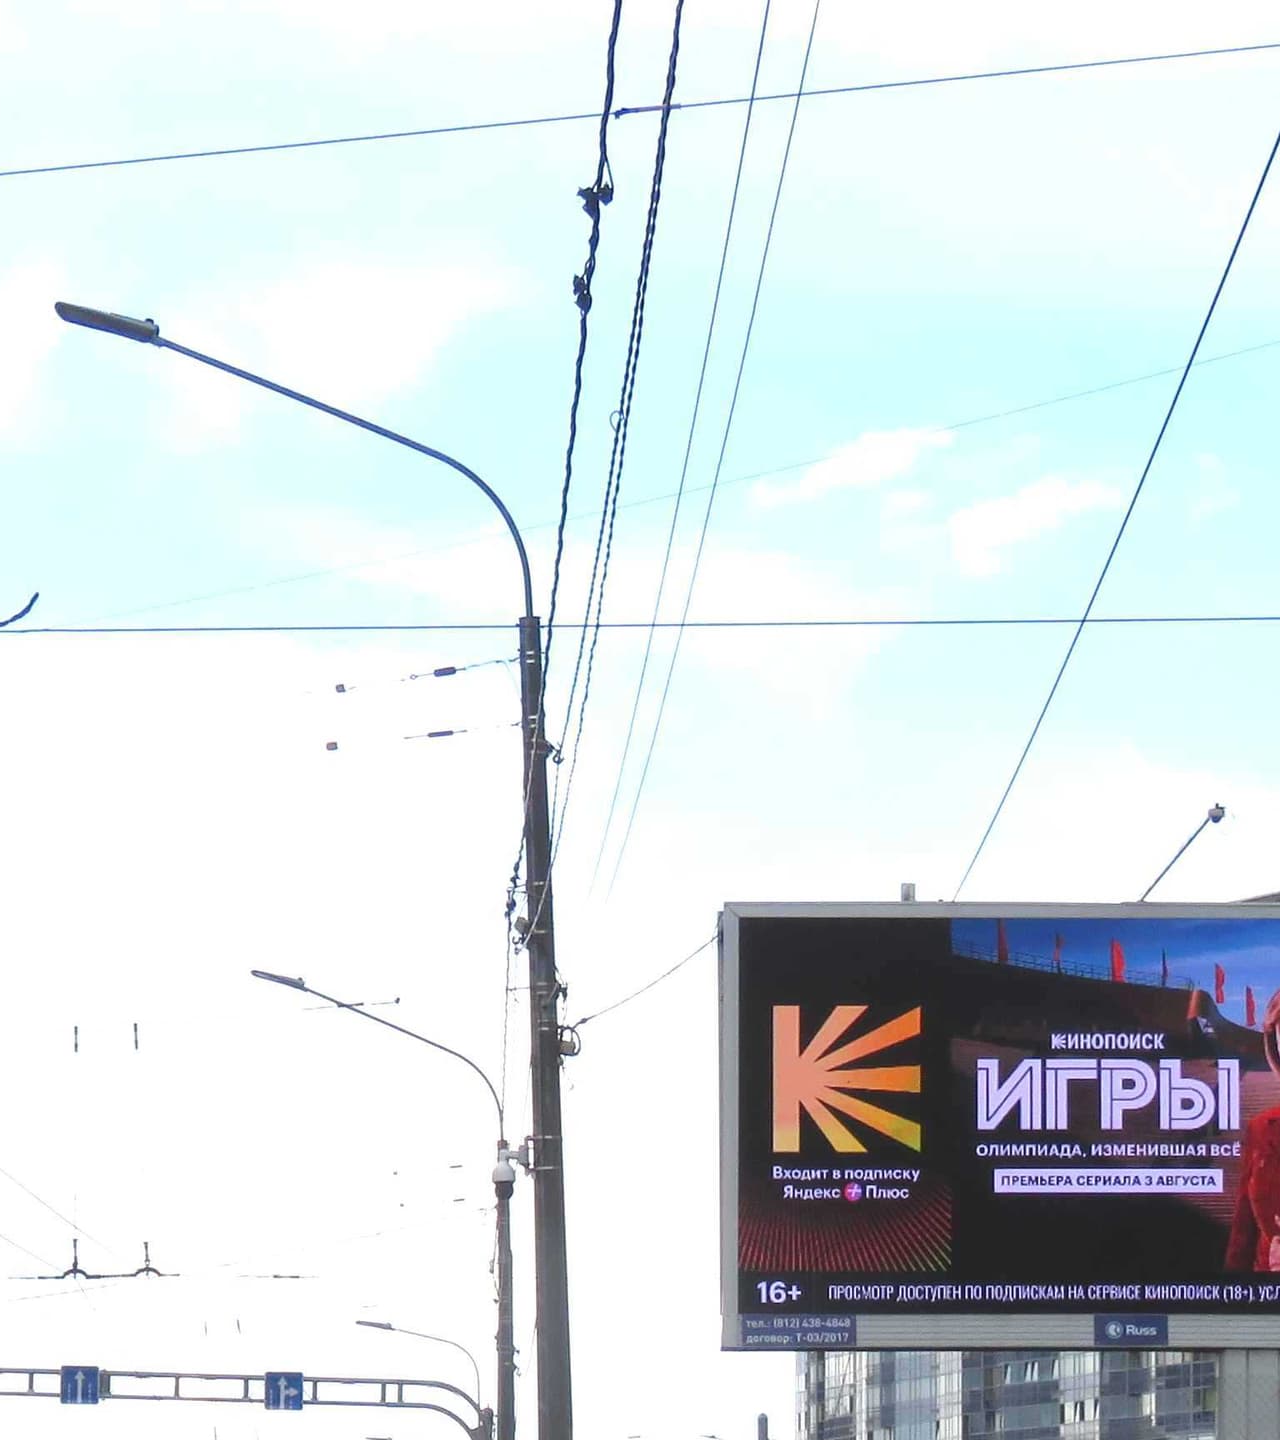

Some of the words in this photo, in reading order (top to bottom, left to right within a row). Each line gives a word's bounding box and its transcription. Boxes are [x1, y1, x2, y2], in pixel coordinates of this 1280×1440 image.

[1050, 1033, 1166, 1050] КИНОПОИСК
[976, 1058, 1241, 1131] ИГРЫ
[975, 1144, 1087, 1158] ОЛИМПИАДА,
[1090, 1144, 1207, 1158] ИЗМЕНИВШАЯ
[1210, 1141, 1241, 1158] ВСЁ
[771, 1165, 829, 1181] Входит
[832, 1168, 841, 1180] в
[843, 1168, 921, 1182] подписку
[1000, 1174, 1073, 1187] ПРЕМЬЕРА
[1075, 1174, 1141, 1187] СЕРИАЛА
[1144, 1175, 1153, 1187] 3
[1155, 1174, 1217, 1187] АВГУСТА
[782, 1184, 841, 1200] Яндекс
[865, 1185, 909, 1199] Плюс
[756, 1281, 802, 1304] 16+
[828, 1284, 894, 1300] ПРОСМОТР
[896, 1284, 962, 1303] ДОСТУПЕН
[964, 1284, 982, 1300] ПО
[985, 1284, 1065, 1302] ПОДПИСКАМ
[1067, 1284, 1085, 1300] НА
[1087, 1284, 1141, 1300] СЕРВИСЕ
[1144, 1284, 1220, 1301] КИНОПОИСК
[773, 1318, 800, 1329] (812)
[1125, 1324, 1157, 1336] Russ
[745, 1333, 794, 1345] договор:
